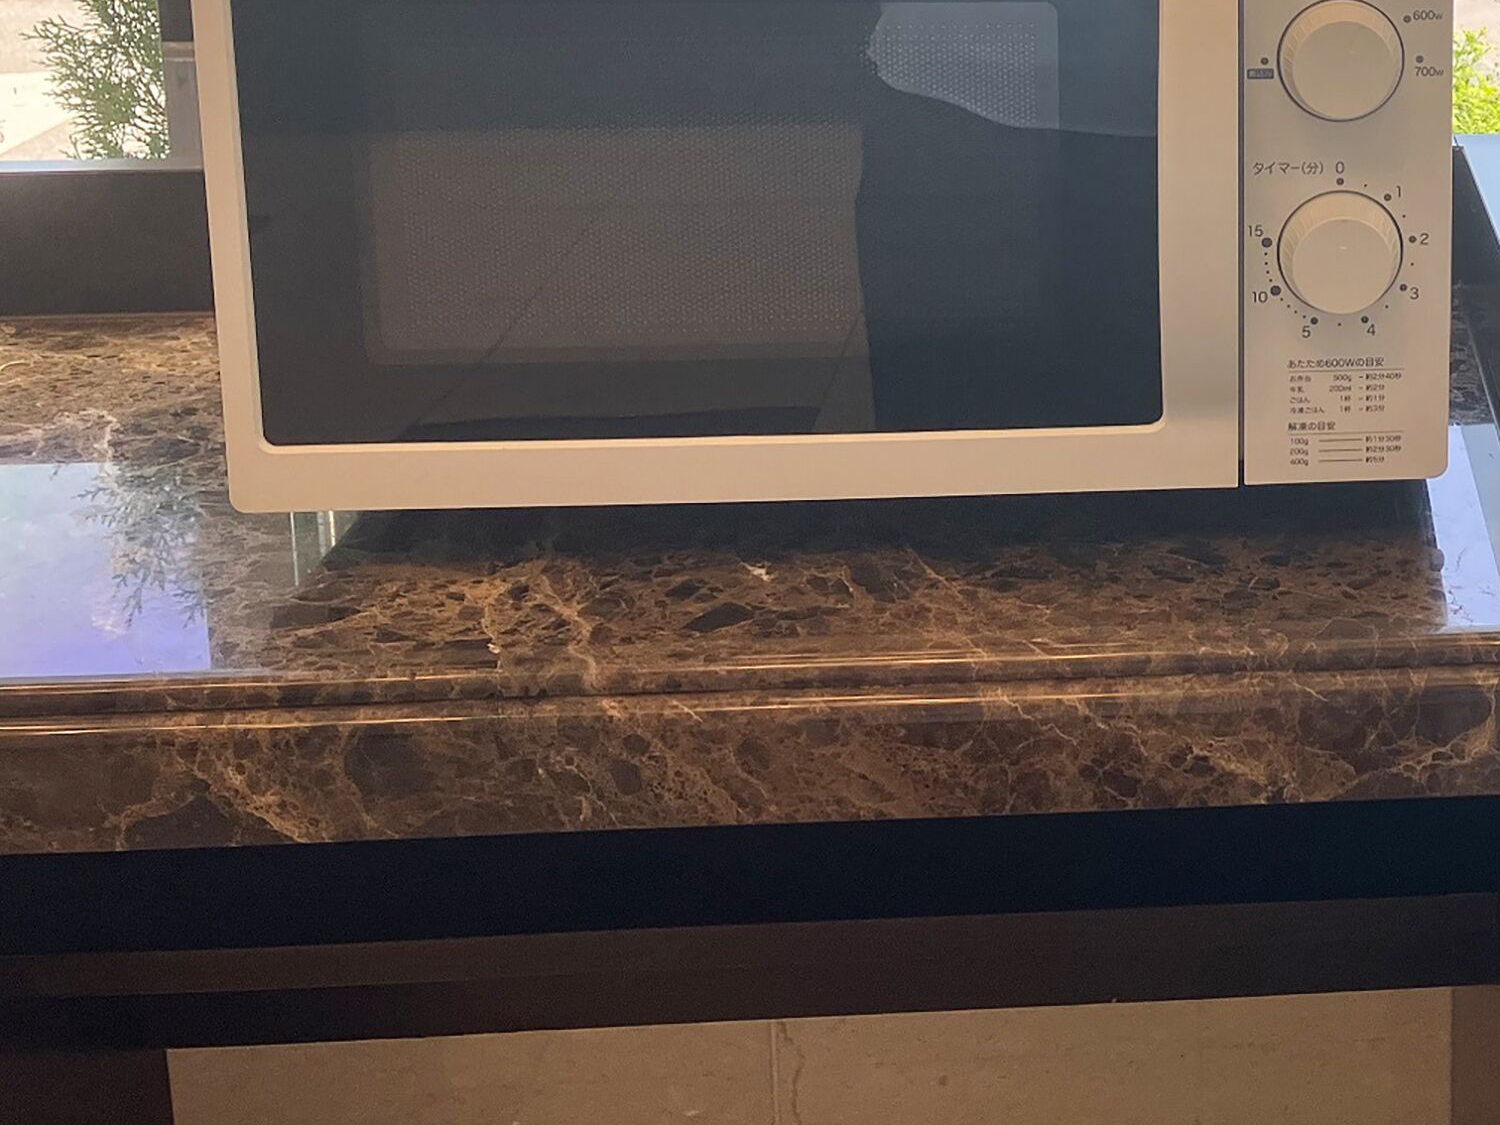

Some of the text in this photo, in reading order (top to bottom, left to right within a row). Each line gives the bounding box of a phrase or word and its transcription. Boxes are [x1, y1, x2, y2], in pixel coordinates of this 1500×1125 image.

[1396, 186, 1401, 198] 1
[1248, 226, 1264, 238] 15
[1420, 233, 1429, 245] 2
[1252, 291, 1268, 304] 10
[1409, 288, 1419, 300] 3
[1302, 326, 1311, 339] 5
[1367, 323, 1376, 336] 4
